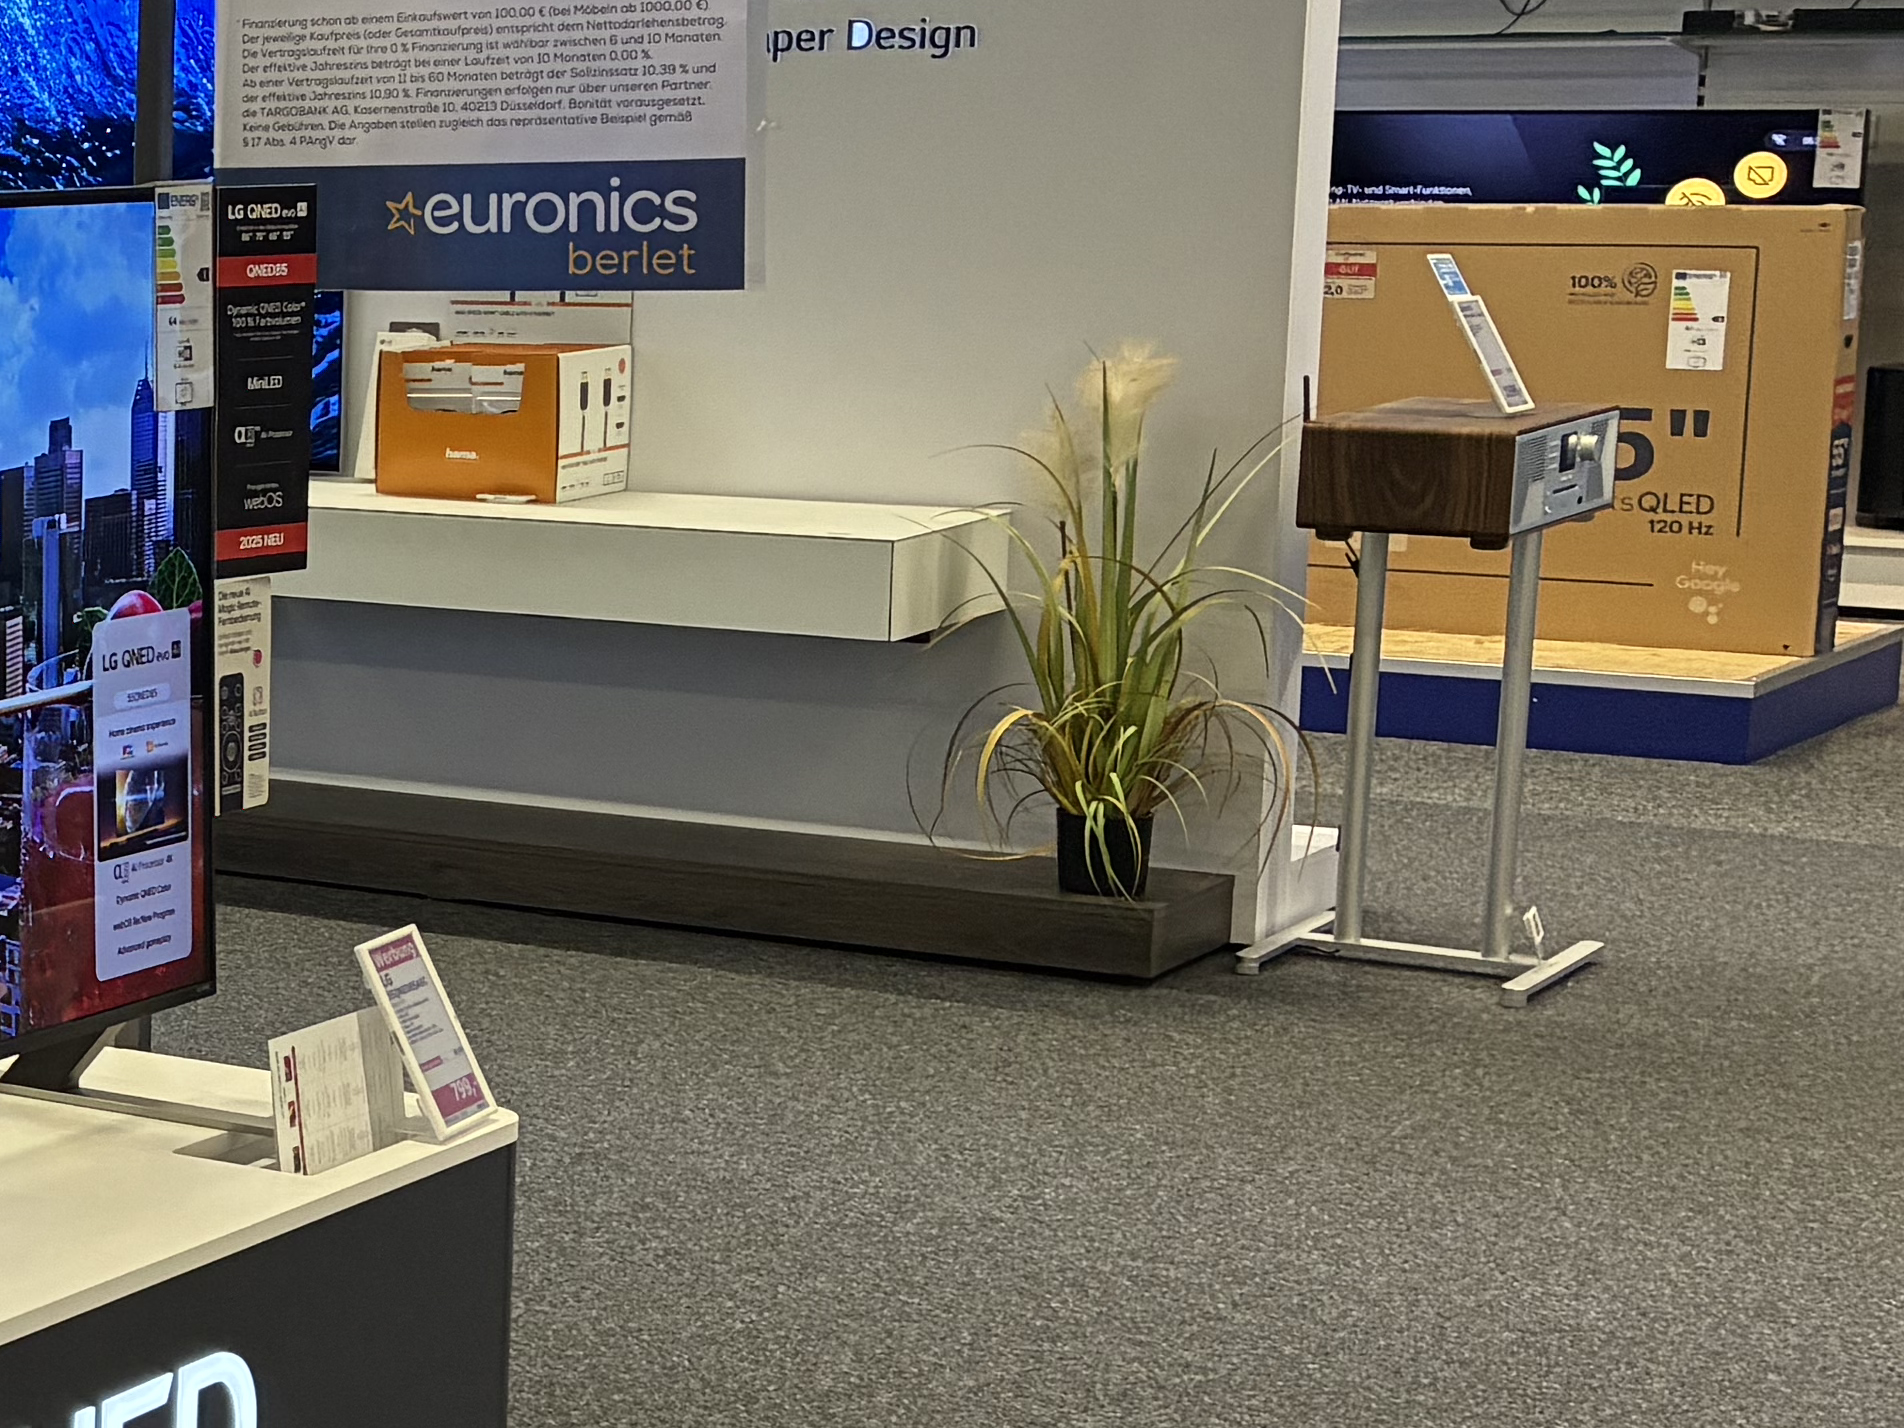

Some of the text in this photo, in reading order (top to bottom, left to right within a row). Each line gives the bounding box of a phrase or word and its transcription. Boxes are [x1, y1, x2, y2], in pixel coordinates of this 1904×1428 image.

[242, 34, 259, 44] Der
[262, 33, 306, 45] jeweilige
[310, 29, 361, 42] Kaufpreis
[364, 28, 392, 40] (oder
[496, 23, 554, 36] entspricht
[557, 21, 583, 32] dem
[767, 18, 976, 62] per Design
[242, 108, 257, 118] die
[261, 106, 329, 117] TARGOBANK
[354, 102, 440, 115] Kasernenstraße
[569, 98, 612, 109] Bonität
[251, 137, 261, 148] 17
[290, 136, 296, 146] 4
[228, 203, 281, 219] LG QNED
[422, 177, 697, 234] euronics
[569, 242, 696, 276] berlet
[1570, 274, 1617, 290] 100%
[247, 375, 283, 390] MiniLED
[243, 491, 284, 510] webOS
[1648, 519, 1714, 536] 120 Hz
[239, 533, 284, 549] 2025 NEU
[1692, 562, 1727, 577] Hey
[1676, 575, 1740, 594] Google
[102, 652, 118, 672] LG
[122, 645, 155, 669] QNED
[374, 941, 417, 969] Werbung
